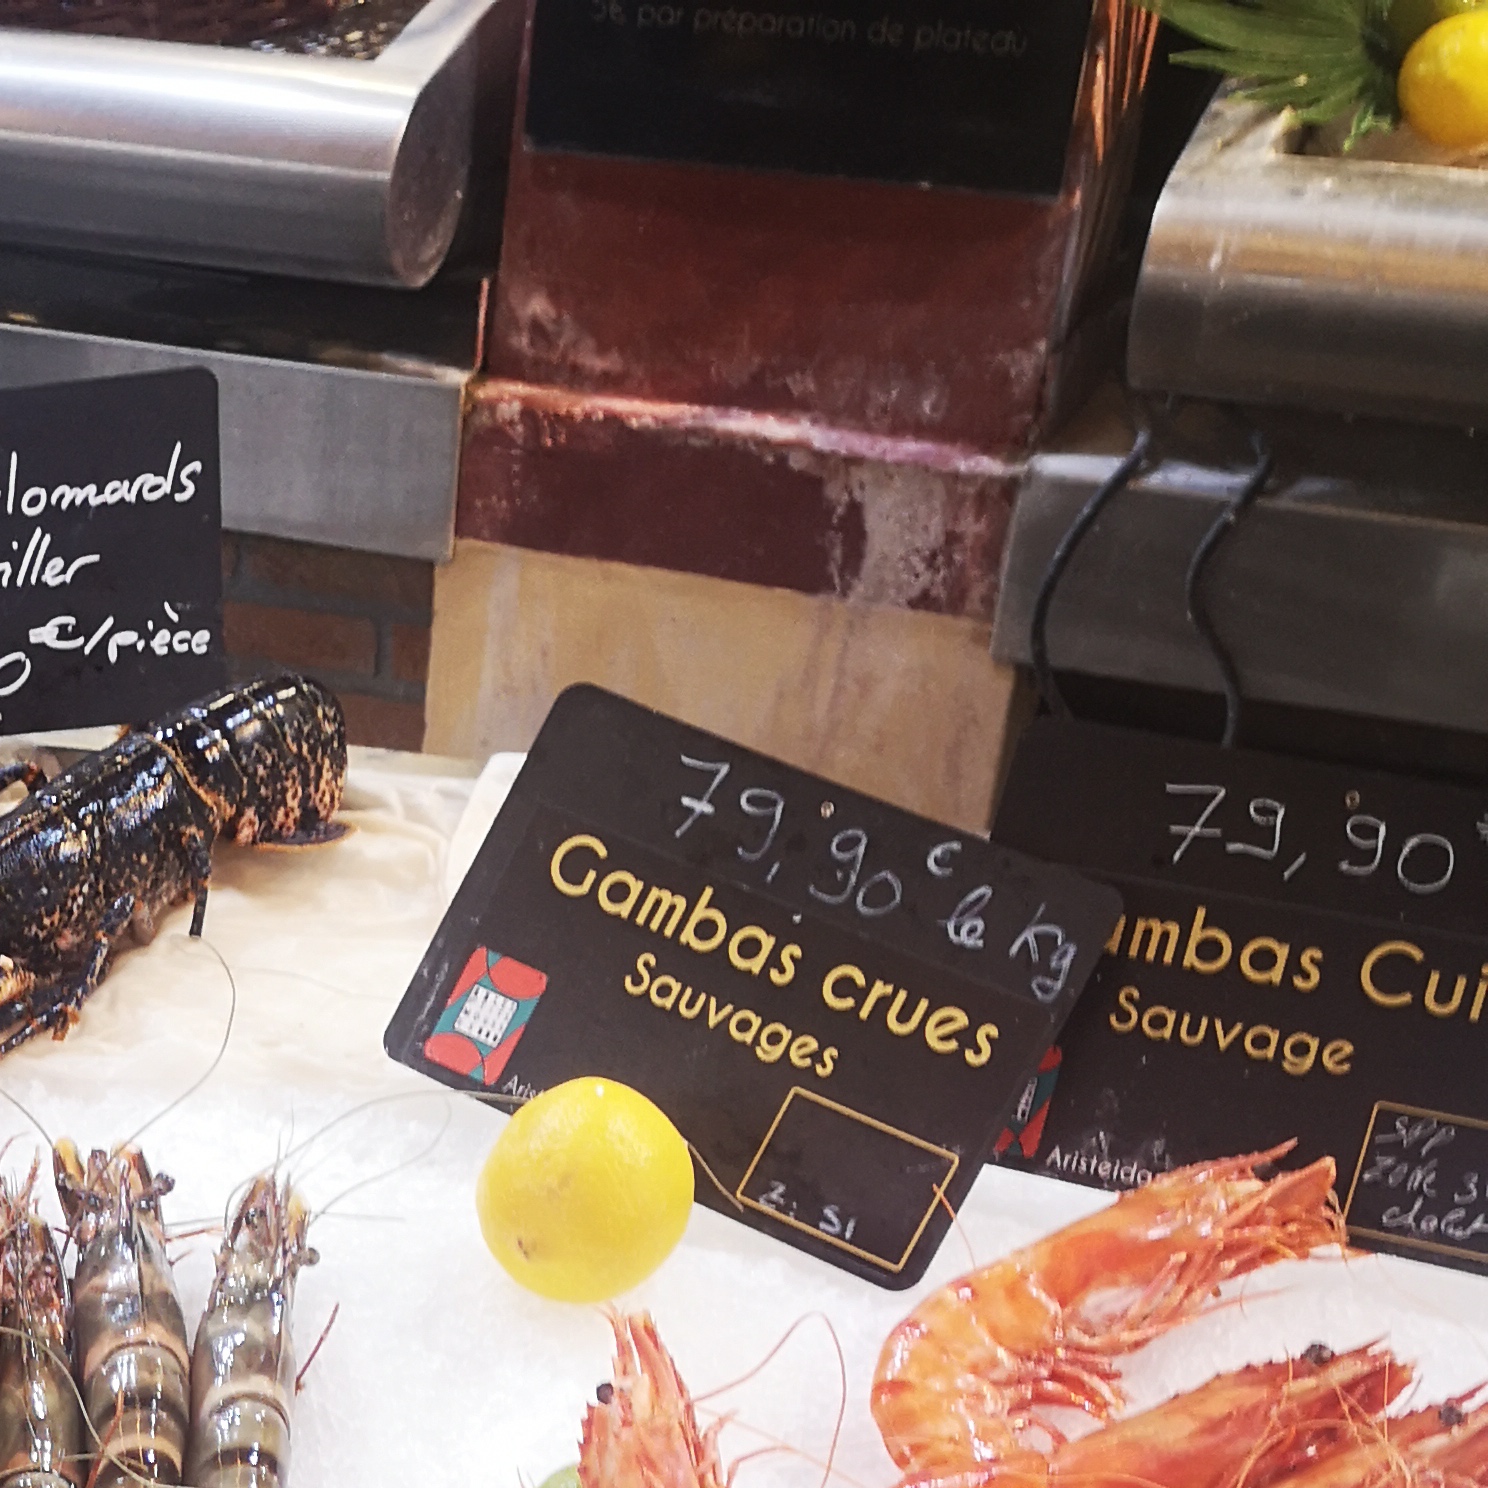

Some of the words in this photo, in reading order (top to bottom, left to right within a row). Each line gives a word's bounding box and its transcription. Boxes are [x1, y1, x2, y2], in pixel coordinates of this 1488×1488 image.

[866, 14, 905, 47] de
[675, 753, 902, 916] 79,90
[1165, 782, 1455, 894] 79,90
[550, 833, 805, 989] Gambas
[821, 963, 1001, 1069] crues
[1104, 904, 1324, 992] mbas
[1360, 939, 1488, 1024] Cui
[624, 951, 840, 1078] Sauvages
[1109, 985, 1355, 1077] Sauvage
[1045, 1143, 1153, 1187] Aristeida
